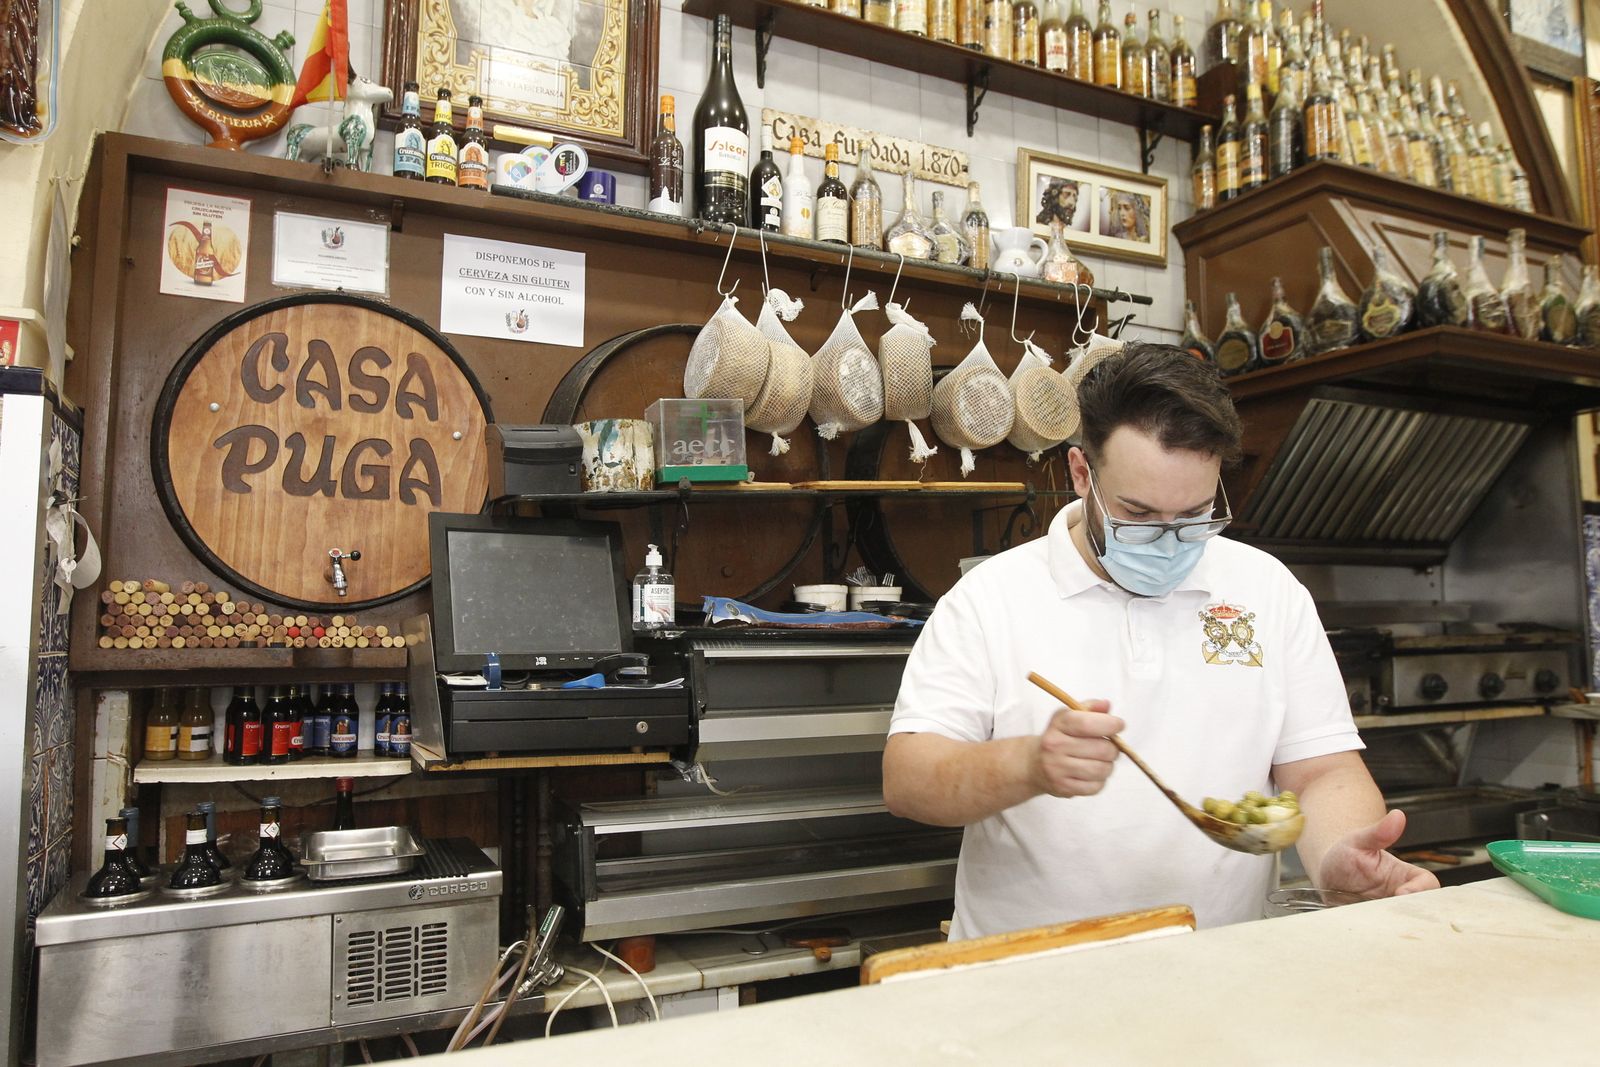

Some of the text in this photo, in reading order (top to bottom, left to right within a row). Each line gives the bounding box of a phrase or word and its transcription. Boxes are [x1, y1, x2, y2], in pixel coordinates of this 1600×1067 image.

[772, 117, 822, 149] Casa
[430, 161, 454, 171] TRIGO
[475, 251, 556, 270] DISPONEMOS DE
[459, 267, 571, 289] CERVEZA SIN GLUTEN
[465, 286, 565, 305] CON Y SIN ALCOHOL
[241, 332, 439, 422] CASA
[673, 439, 735, 456] aecc
[213, 424, 442, 507] PUGA
